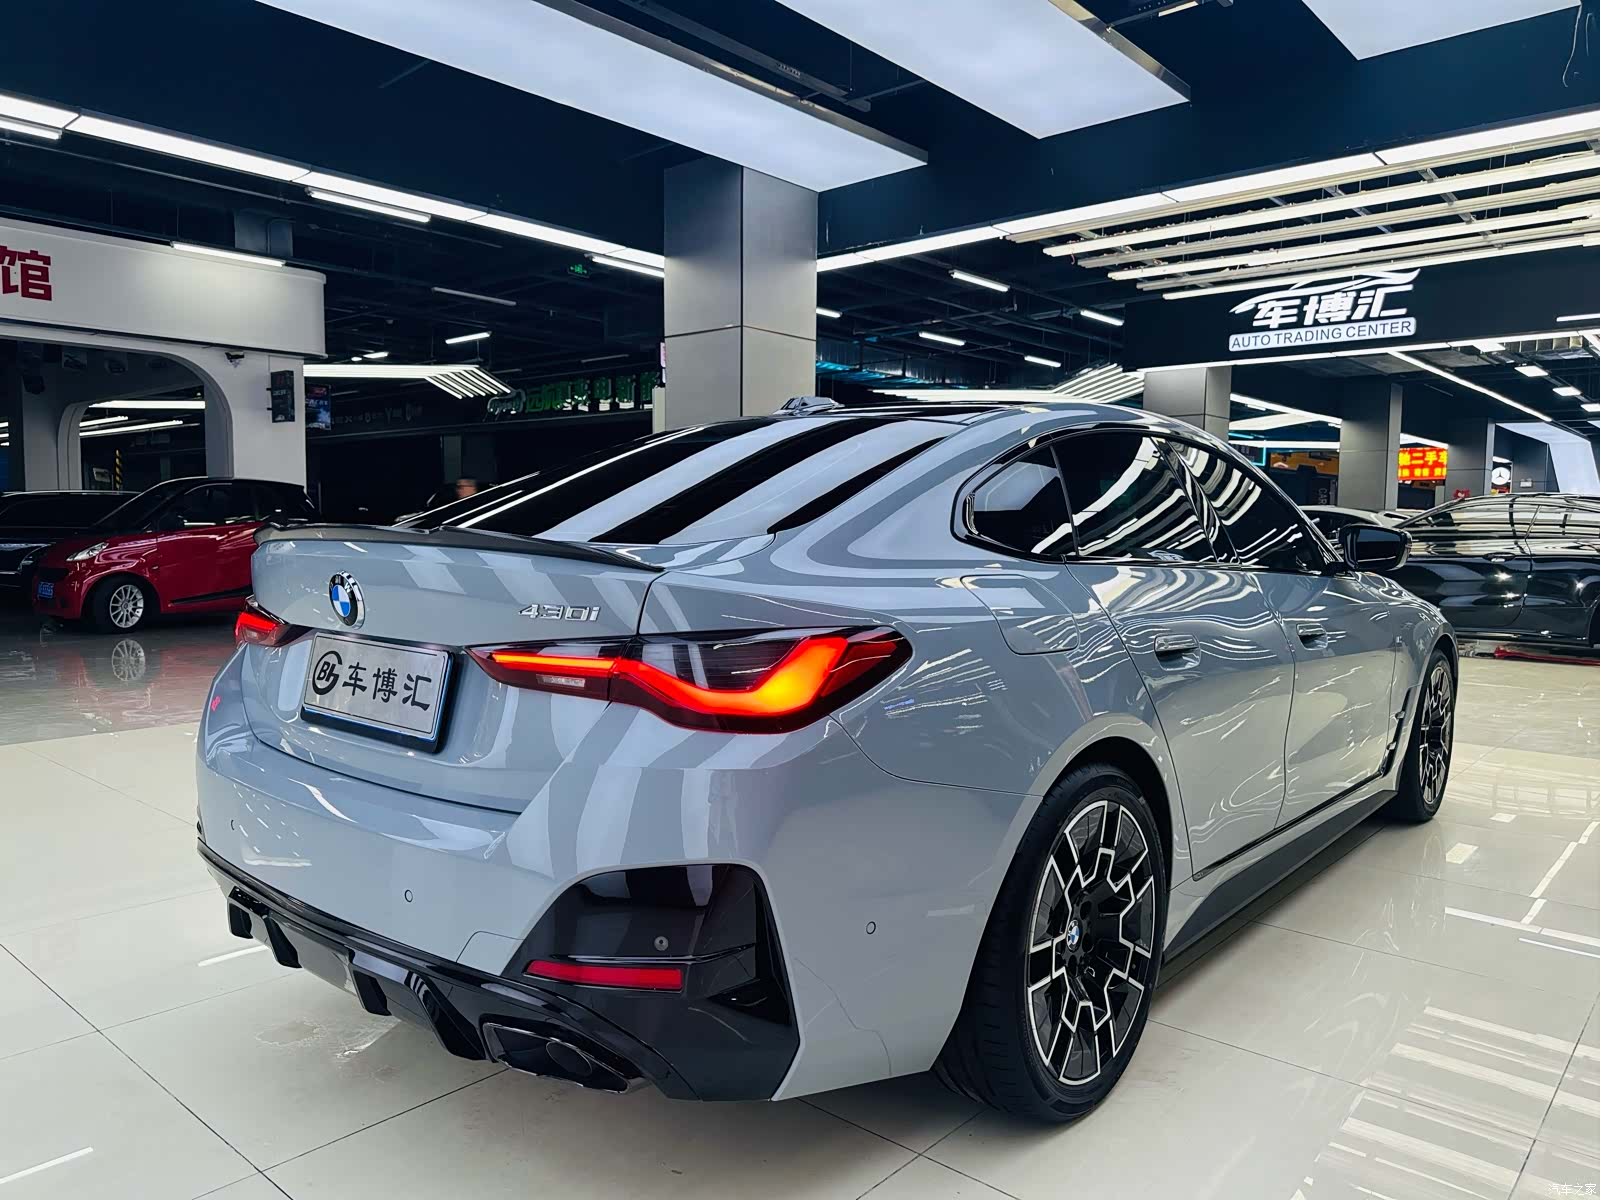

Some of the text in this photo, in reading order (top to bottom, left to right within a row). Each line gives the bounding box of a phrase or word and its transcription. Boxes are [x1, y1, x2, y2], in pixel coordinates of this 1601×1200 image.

[0, 245, 52, 301] 馆
[1252, 284, 1414, 328] 车博汇
[1231, 321, 1412, 349] AUTO TRADING CENTER
[518, 604, 600, 621] 430i
[342, 662, 432, 711] 车博汇
